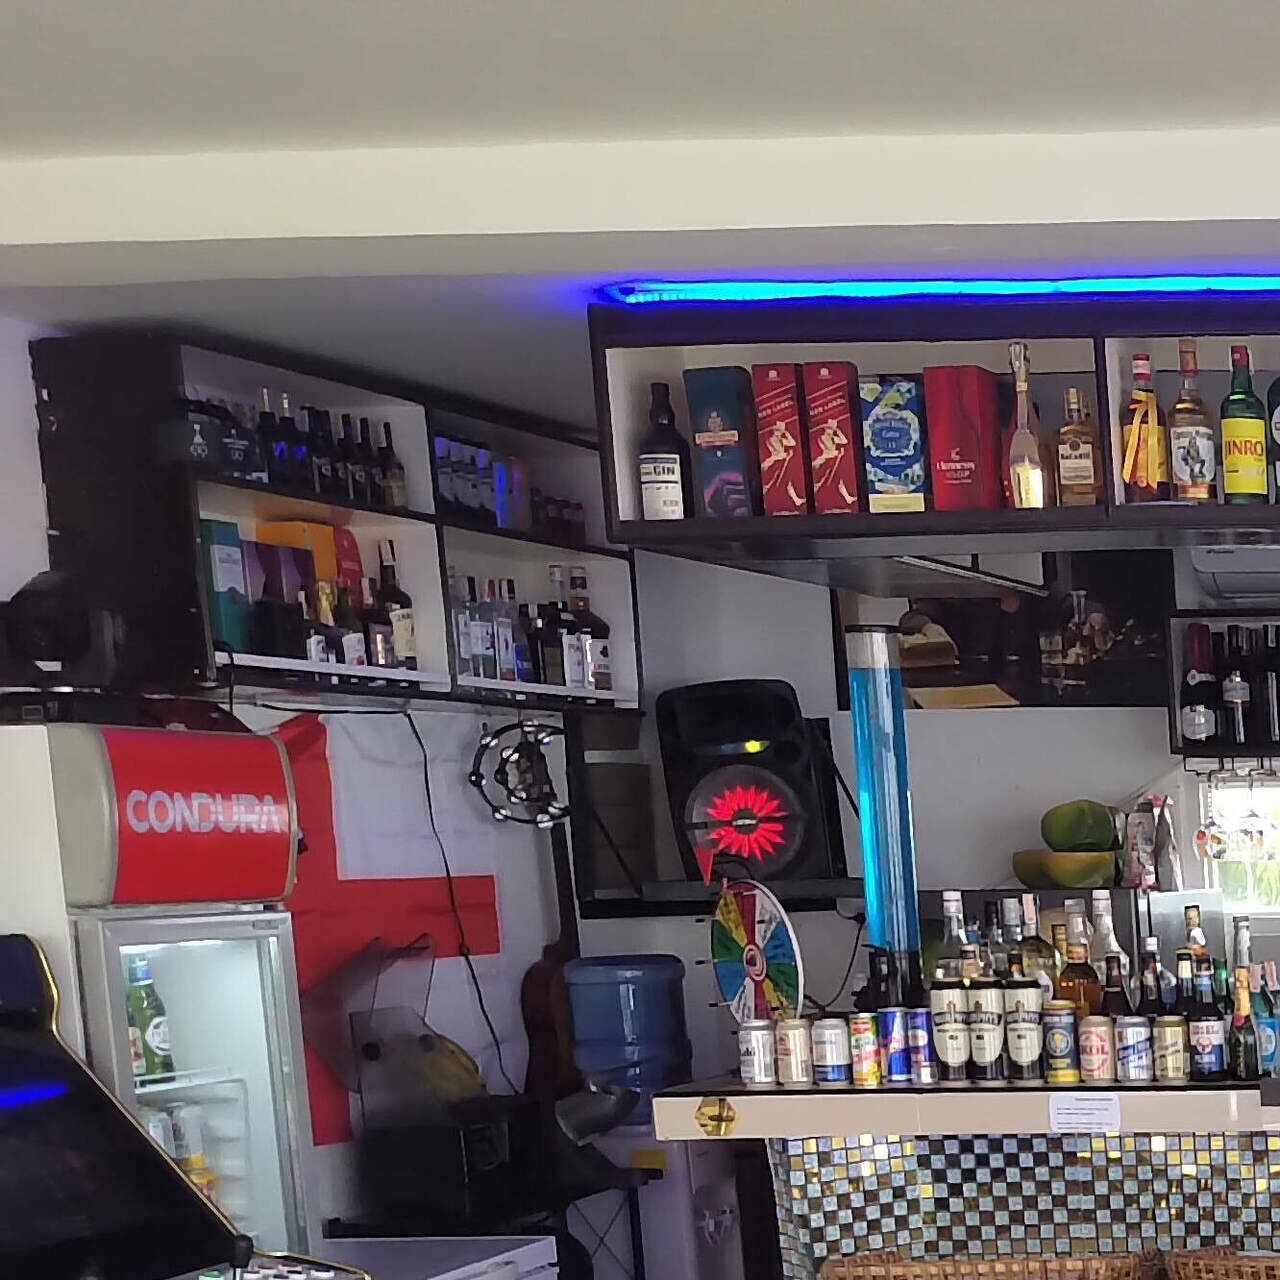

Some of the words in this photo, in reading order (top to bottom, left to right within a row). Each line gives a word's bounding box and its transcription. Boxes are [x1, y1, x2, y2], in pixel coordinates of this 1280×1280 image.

[1225, 439, 1264, 461] JINRO
[653, 465, 676, 477] GIN
[126, 789, 281, 834] CONDURA
